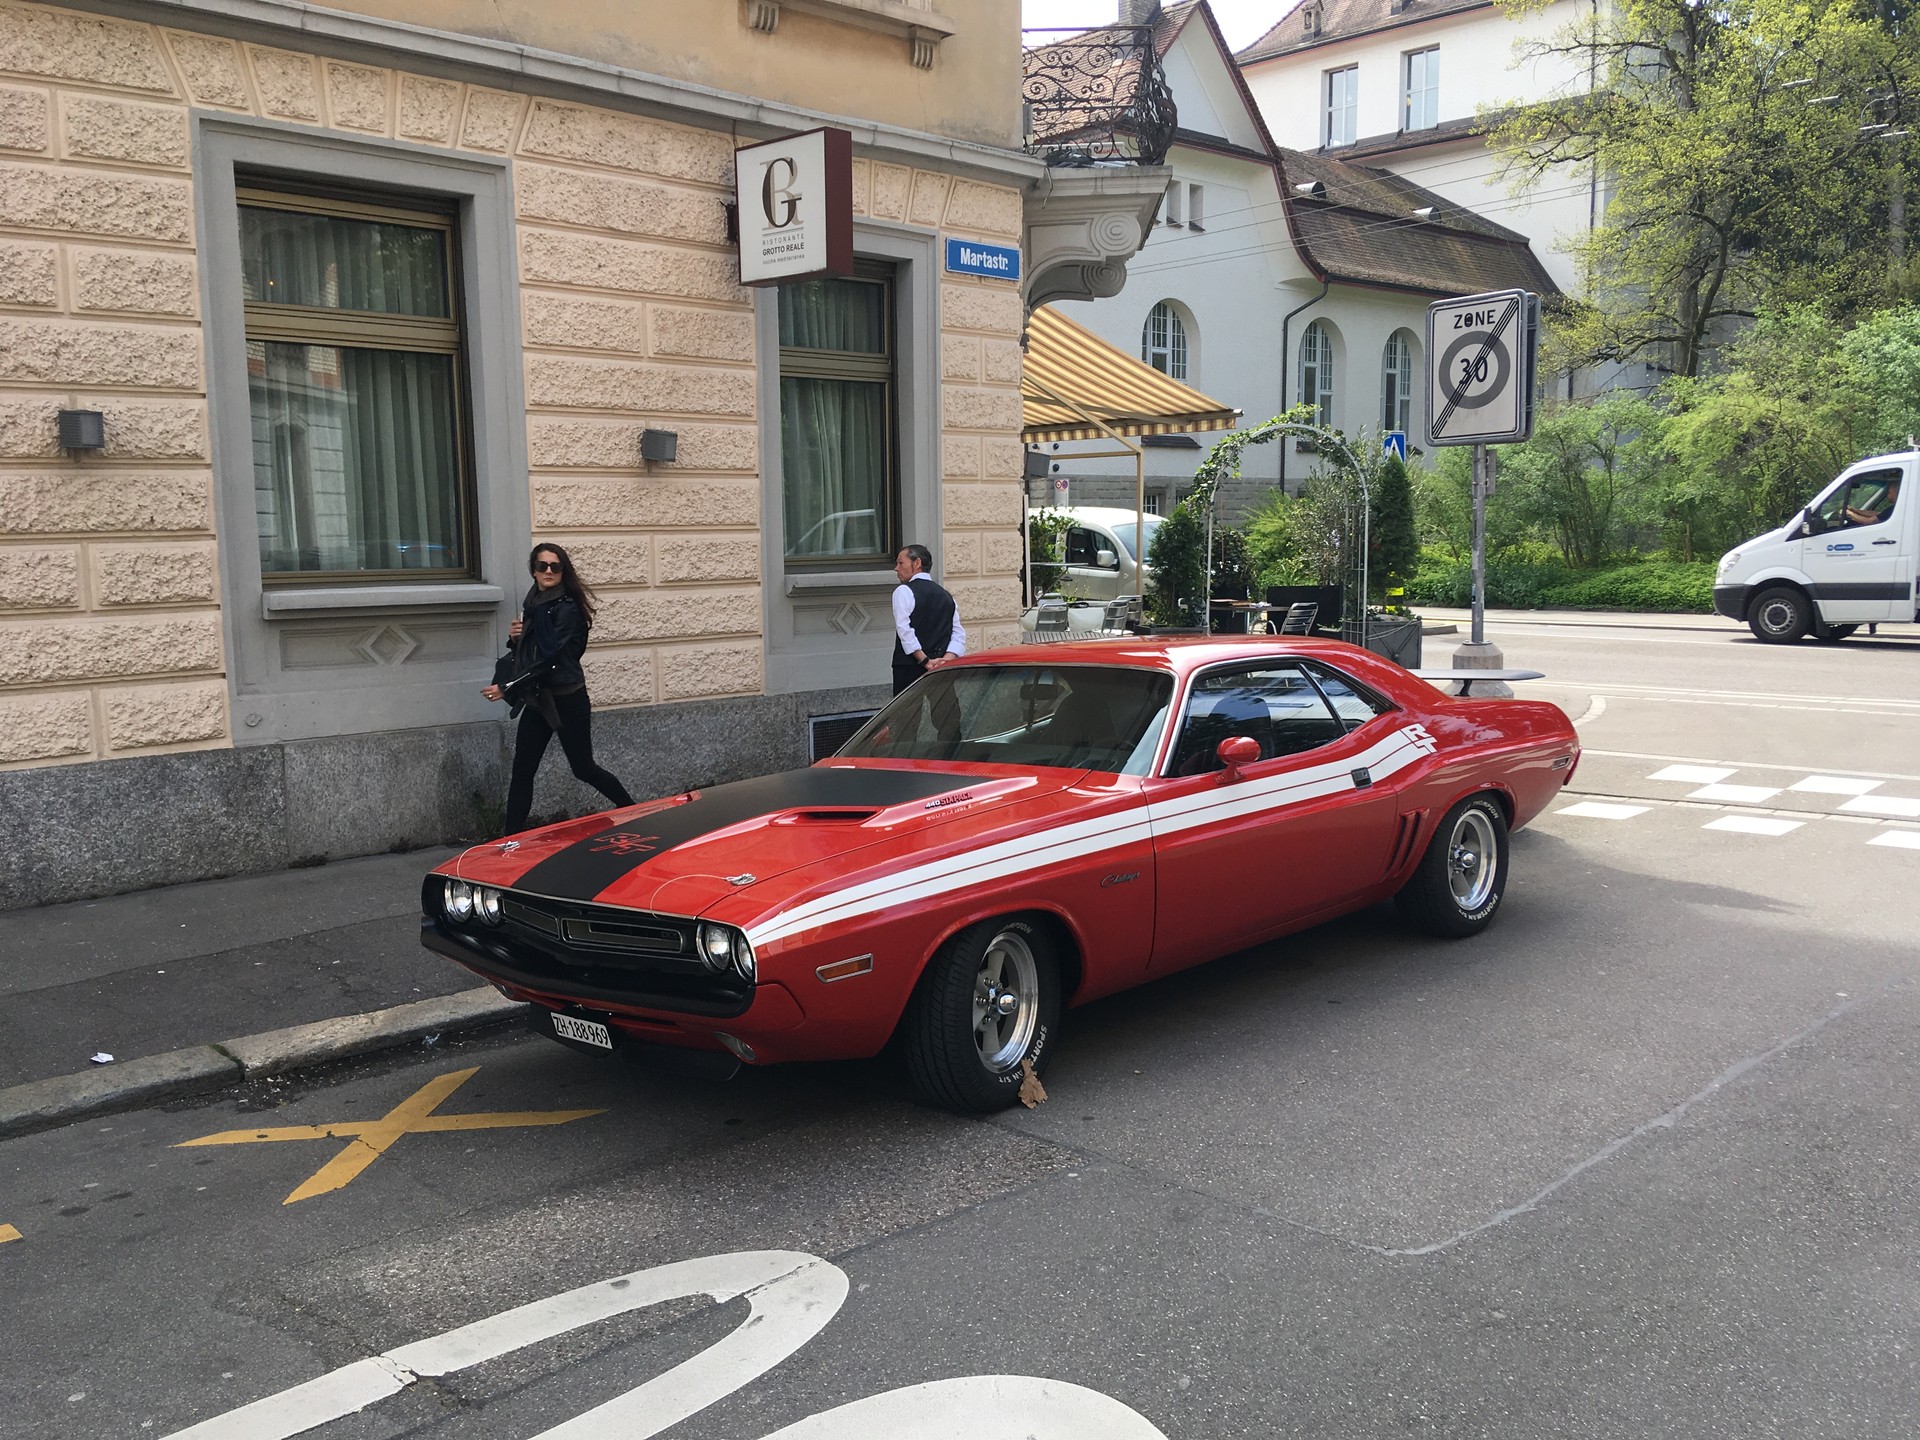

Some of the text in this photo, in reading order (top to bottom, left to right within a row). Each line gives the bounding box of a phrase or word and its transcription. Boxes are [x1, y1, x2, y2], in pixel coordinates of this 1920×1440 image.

[762, 233, 805, 246] RISTORANTE
[762, 242, 805, 256] GROTTO REALE
[960, 247, 1009, 271] Martastr.
[1453, 309, 1496, 329] ZONE
[1459, 356, 1489, 385] 30
[925, 799, 941, 809] 440
[1468, 893, 1498, 920] SPORTSMAN
